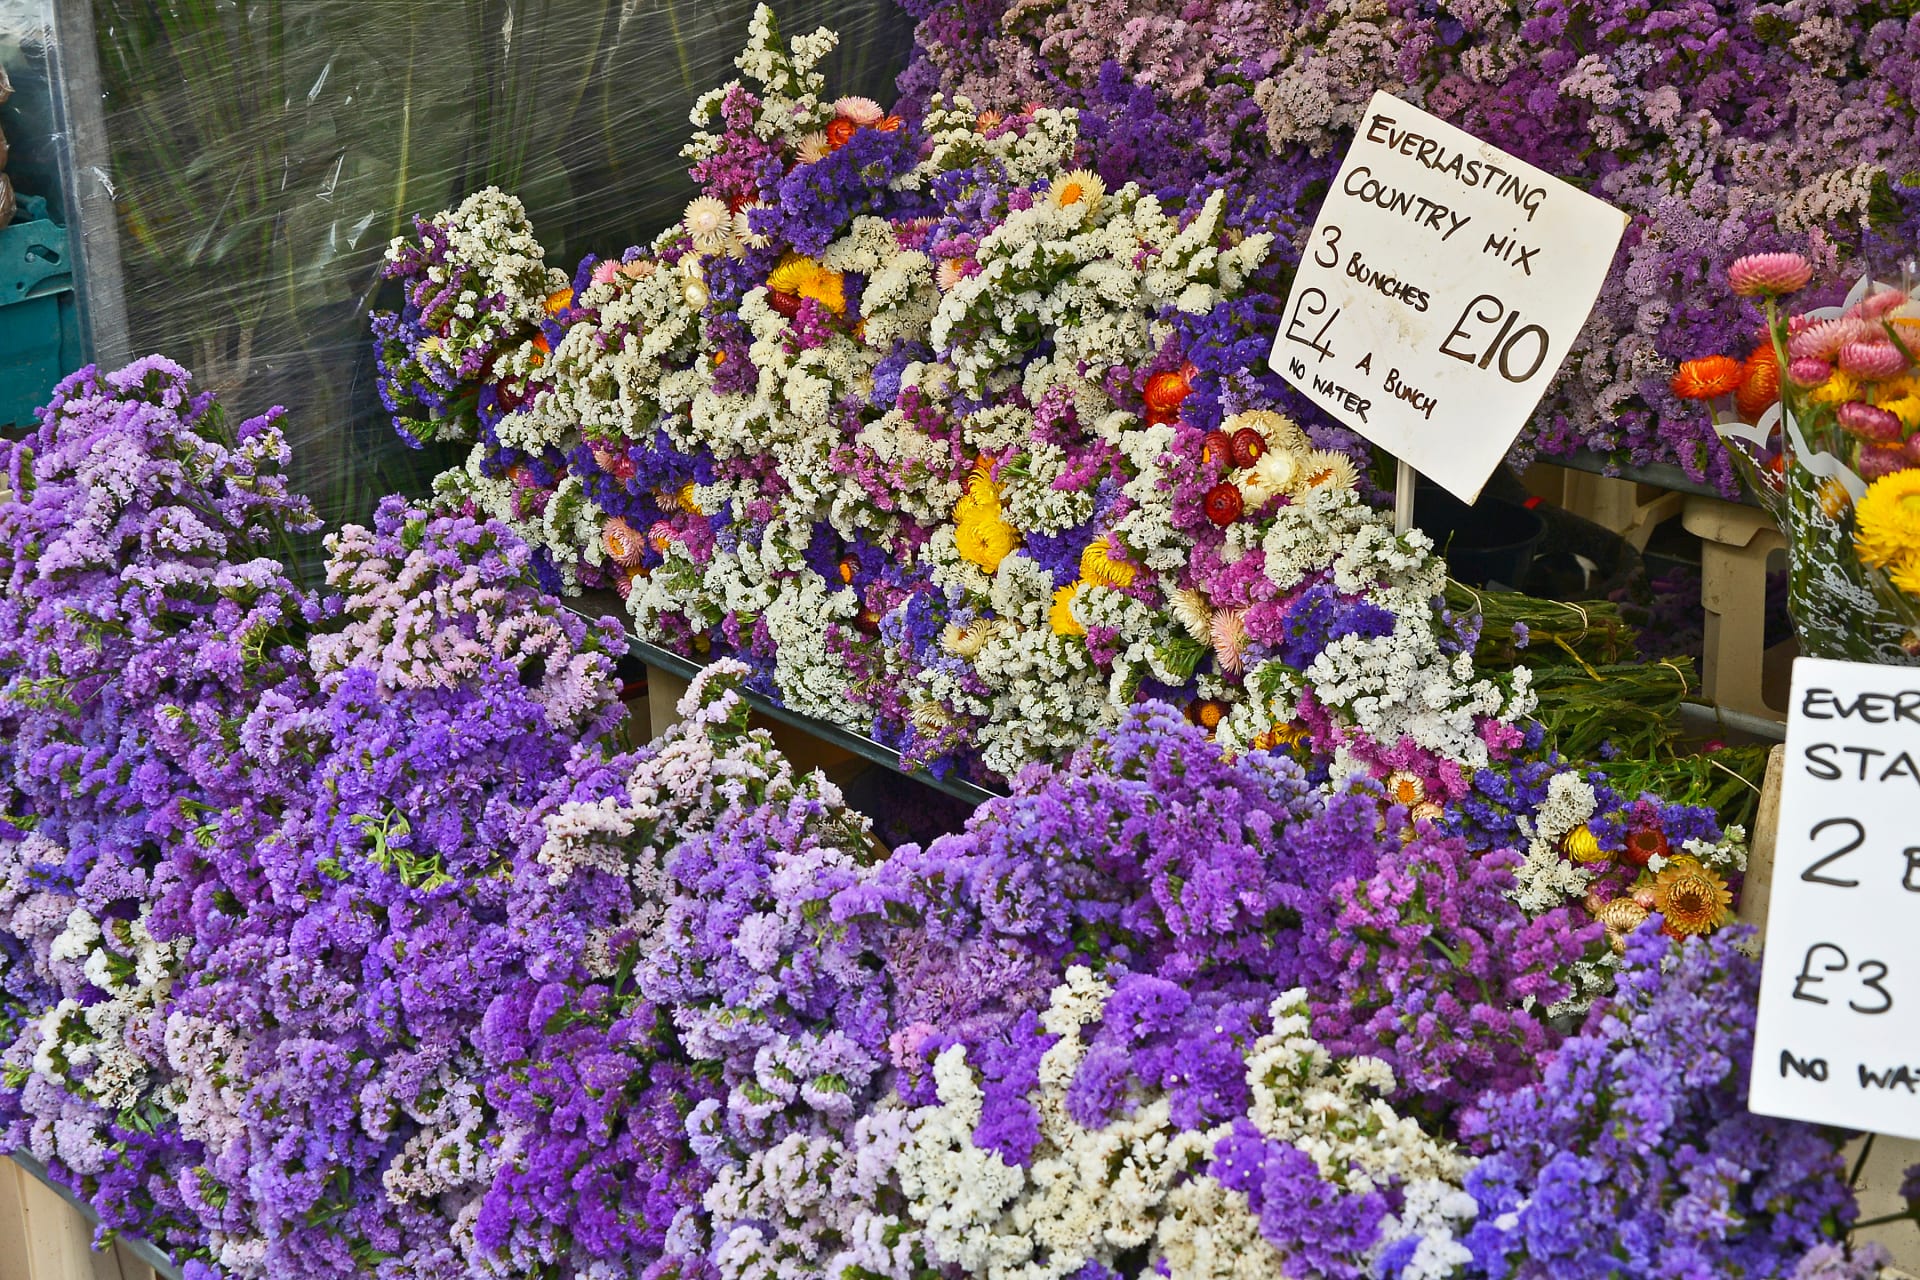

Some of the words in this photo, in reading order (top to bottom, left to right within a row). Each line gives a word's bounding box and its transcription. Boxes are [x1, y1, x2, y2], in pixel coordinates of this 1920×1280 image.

[1343, 166, 1472, 242] COUNTRY
[1367, 114, 1547, 222] EVERLASTING
[1315, 225, 1342, 269] 3
[1345, 251, 1431, 313] BUNCHES
[1438, 294, 1550, 383] £10
[1285, 287, 1341, 364] £4
[1354, 352, 1373, 376] A
[1383, 367, 1438, 420] BUNCH
[1288, 356, 1306, 380] NO
[1312, 374, 1372, 424] WATER
[1800, 817, 1865, 888] 2
[1792, 942, 1893, 1015] £3
[1780, 1049, 1829, 1083] NO
